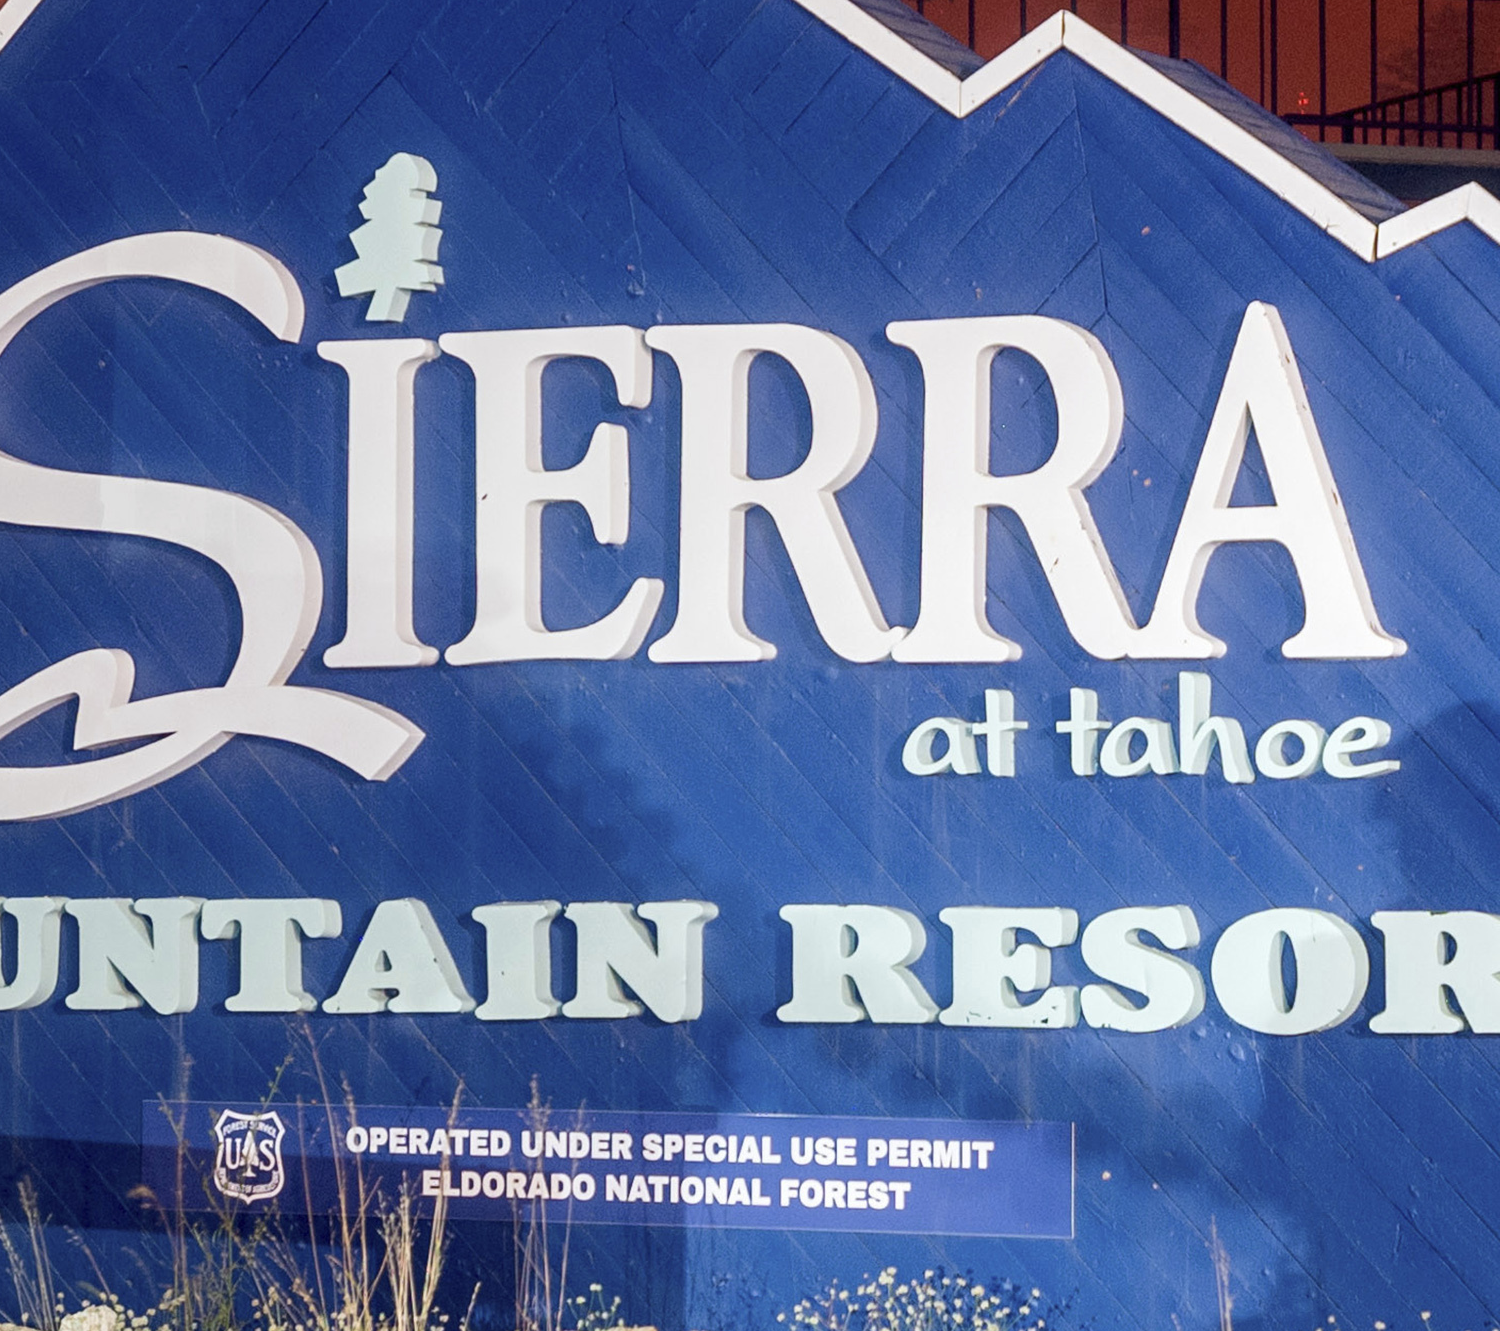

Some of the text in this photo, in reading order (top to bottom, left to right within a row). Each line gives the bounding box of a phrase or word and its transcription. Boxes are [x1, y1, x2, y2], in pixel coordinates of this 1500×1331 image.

[901, 670, 1401, 784] at tahoe
[345, 1126, 995, 1170] OPERATED UNDER SPECIAL USE PERMIT
[421, 1169, 912, 1211] ELDORADO NATIONAL FOREST
